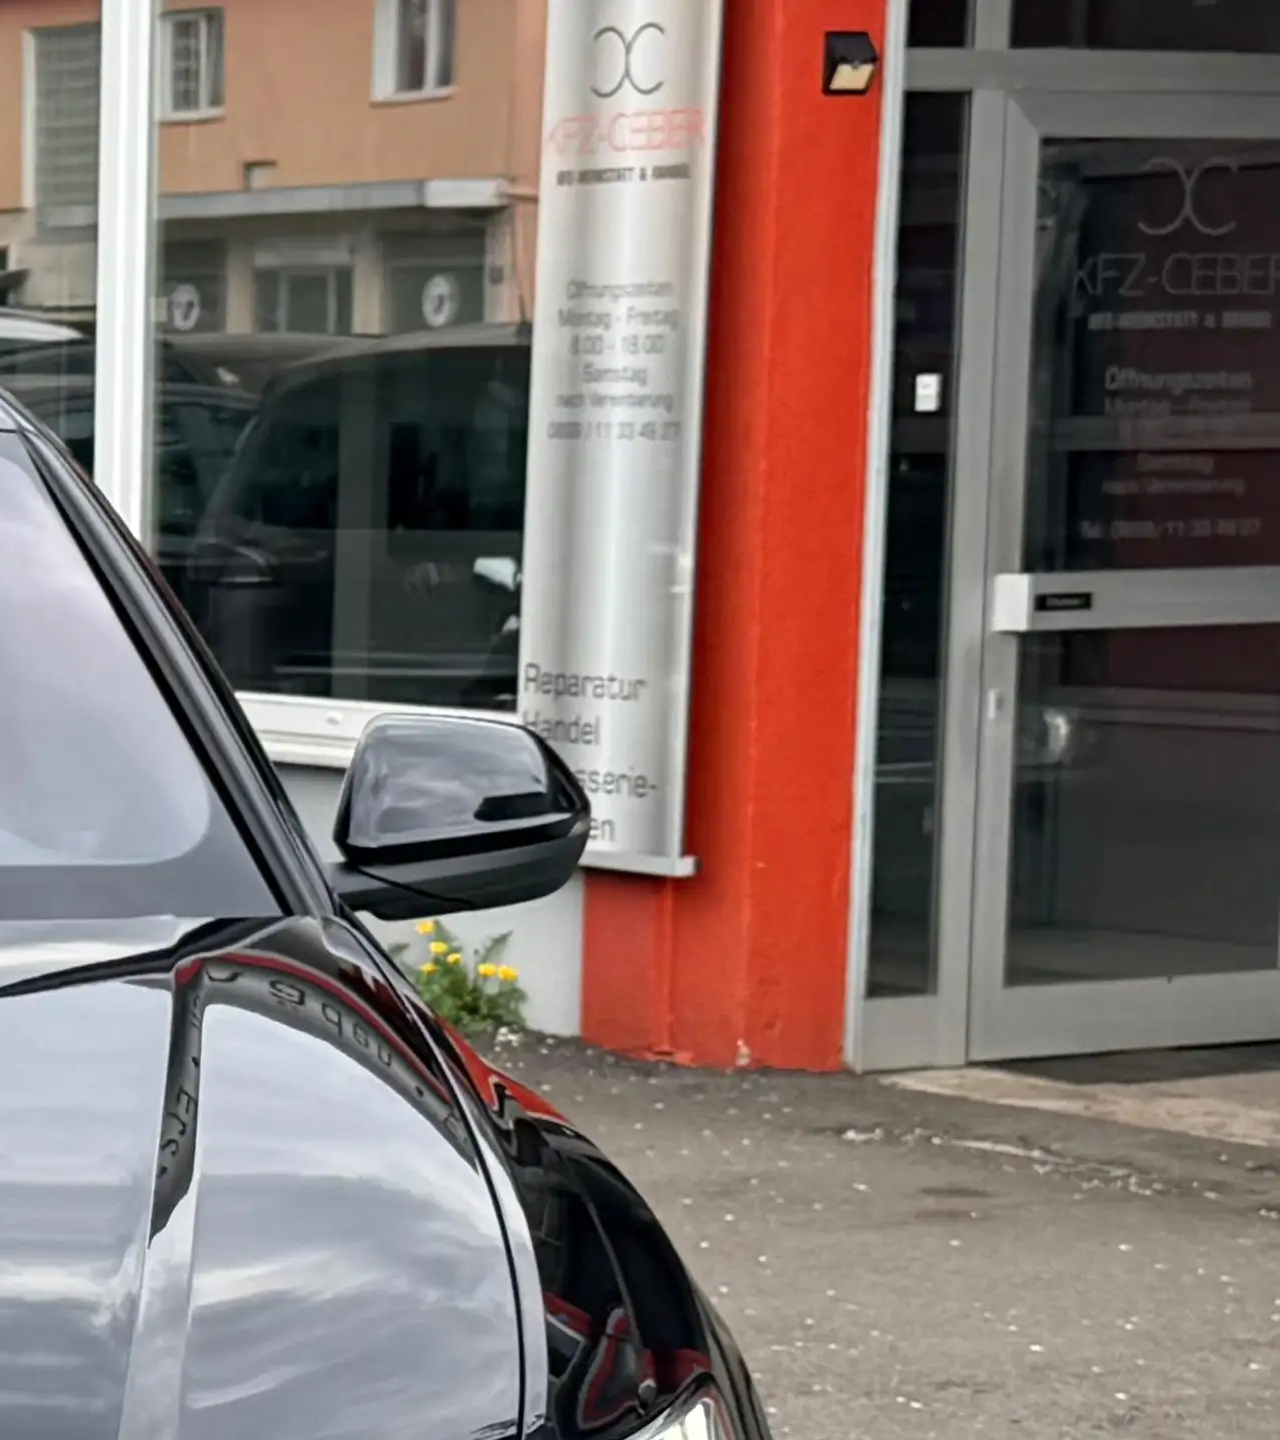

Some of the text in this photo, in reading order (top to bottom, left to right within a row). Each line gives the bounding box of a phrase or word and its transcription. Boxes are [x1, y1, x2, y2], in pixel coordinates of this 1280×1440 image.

[524, 662, 647, 702] Reparatur
[523, 711, 601, 744] Handel
[575, 767, 658, 798] sserie-
